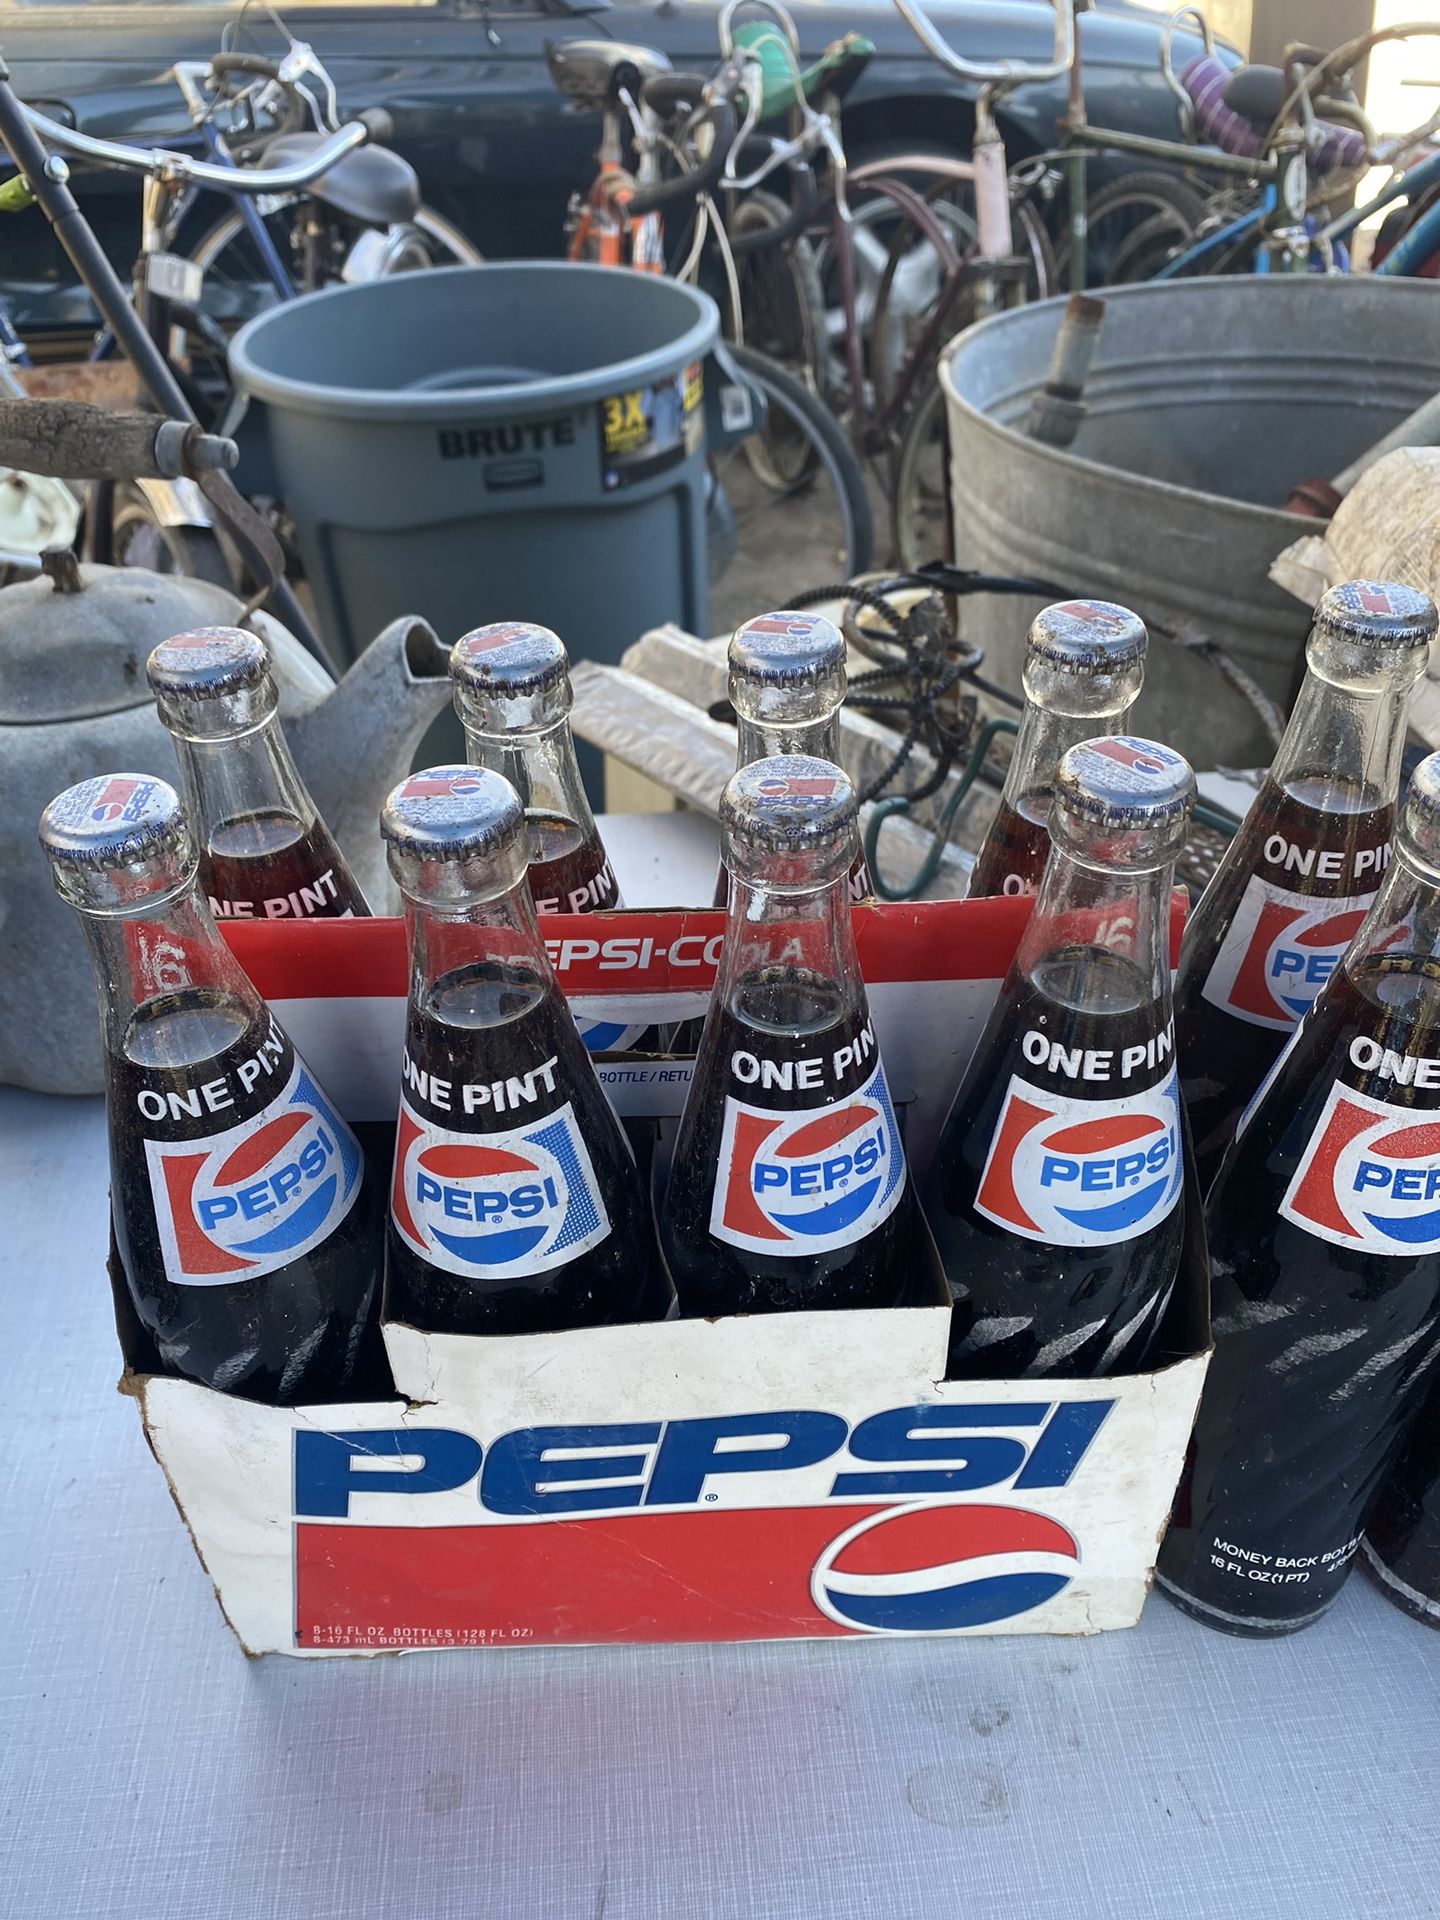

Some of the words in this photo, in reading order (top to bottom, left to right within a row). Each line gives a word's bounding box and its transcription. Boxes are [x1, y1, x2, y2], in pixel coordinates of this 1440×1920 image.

[437, 418, 575, 460] BRUTE
[411, 769, 486, 781] PEPSI
[1114, 736, 1181, 767] PEPSI
[121, 780, 158, 823] PEPSI
[1263, 834, 1346, 880] ONE
[1353, 836, 1397, 879] PIN
[207, 895, 254, 917] NE
[262, 868, 338, 918] PINT
[730, 1050, 825, 1091] ONE
[832, 1016, 875, 1081] PIN
[1022, 1030, 1114, 1082] ONE
[1349, 1035, 1440, 1090] ONE
[137, 1077, 236, 1122] ONE
[402, 1045, 453, 1112] ONE
[462, 1055, 559, 1115] PINT
[197, 1126, 335, 1231] PEPSI
[754, 1126, 887, 1197] PEPSI
[1040, 1125, 1177, 1193] PEPSI
[416, 1170, 559, 1223] PEPSI
[291, 1398, 1118, 1518] PEPSI
[1209, 1554, 1226, 1569] 16
[1226, 1562, 1247, 1578] FL
[1213, 1536, 1273, 1566] MONEY
[1274, 1555, 1319, 1568] BACK
[312, 1625, 343, 1636] 8-16
[346, 1626, 363, 1636] FL
[366, 1626, 385, 1637] OZ
[392, 1627, 453, 1638] BOTTLES
[456, 1628, 487, 1639] (128
[490, 1628, 507, 1638] FL
[510, 1628, 534, 1638] OZ)
[312, 1635, 351, 1645] 8-473
[355, 1636, 375, 1645] mL
[379, 1636, 438, 1646] BOTTLES
